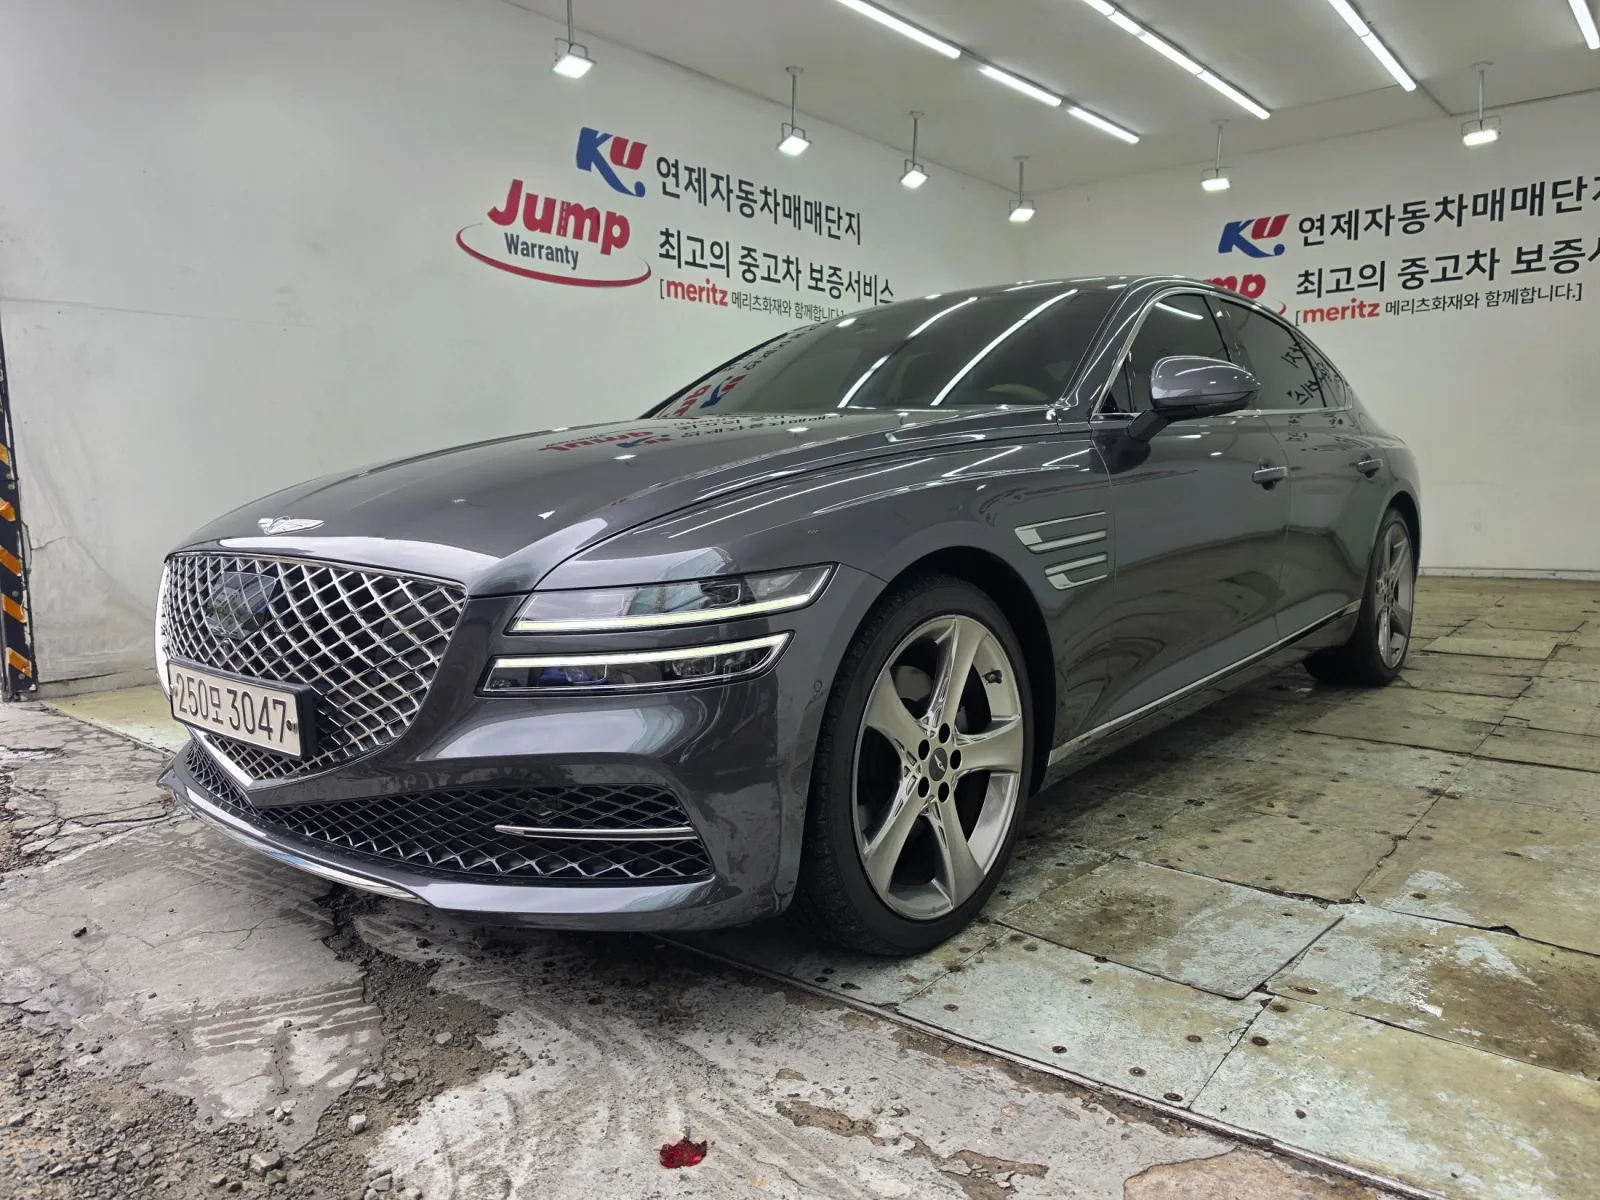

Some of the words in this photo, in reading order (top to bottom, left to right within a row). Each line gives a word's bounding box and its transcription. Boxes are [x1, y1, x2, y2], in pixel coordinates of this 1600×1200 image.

[487, 179, 631, 256] Jump
[656, 155, 862, 246] 연제자동차매매단지
[503, 231, 580, 271] Warranty
[658, 227, 731, 279] 최고의
[738, 244, 802, 292] 중고차
[807, 263, 896, 307] 보증서비스
[1296, 260, 1387, 299] 최고의
[1397, 247, 1500, 291] 중고차
[731, 291, 792, 318] 메리츠화재와
[1385, 292, 1480, 317] 메리츠화재와
[176, 673, 223, 725] 250모
[227, 688, 286, 743] 3047
